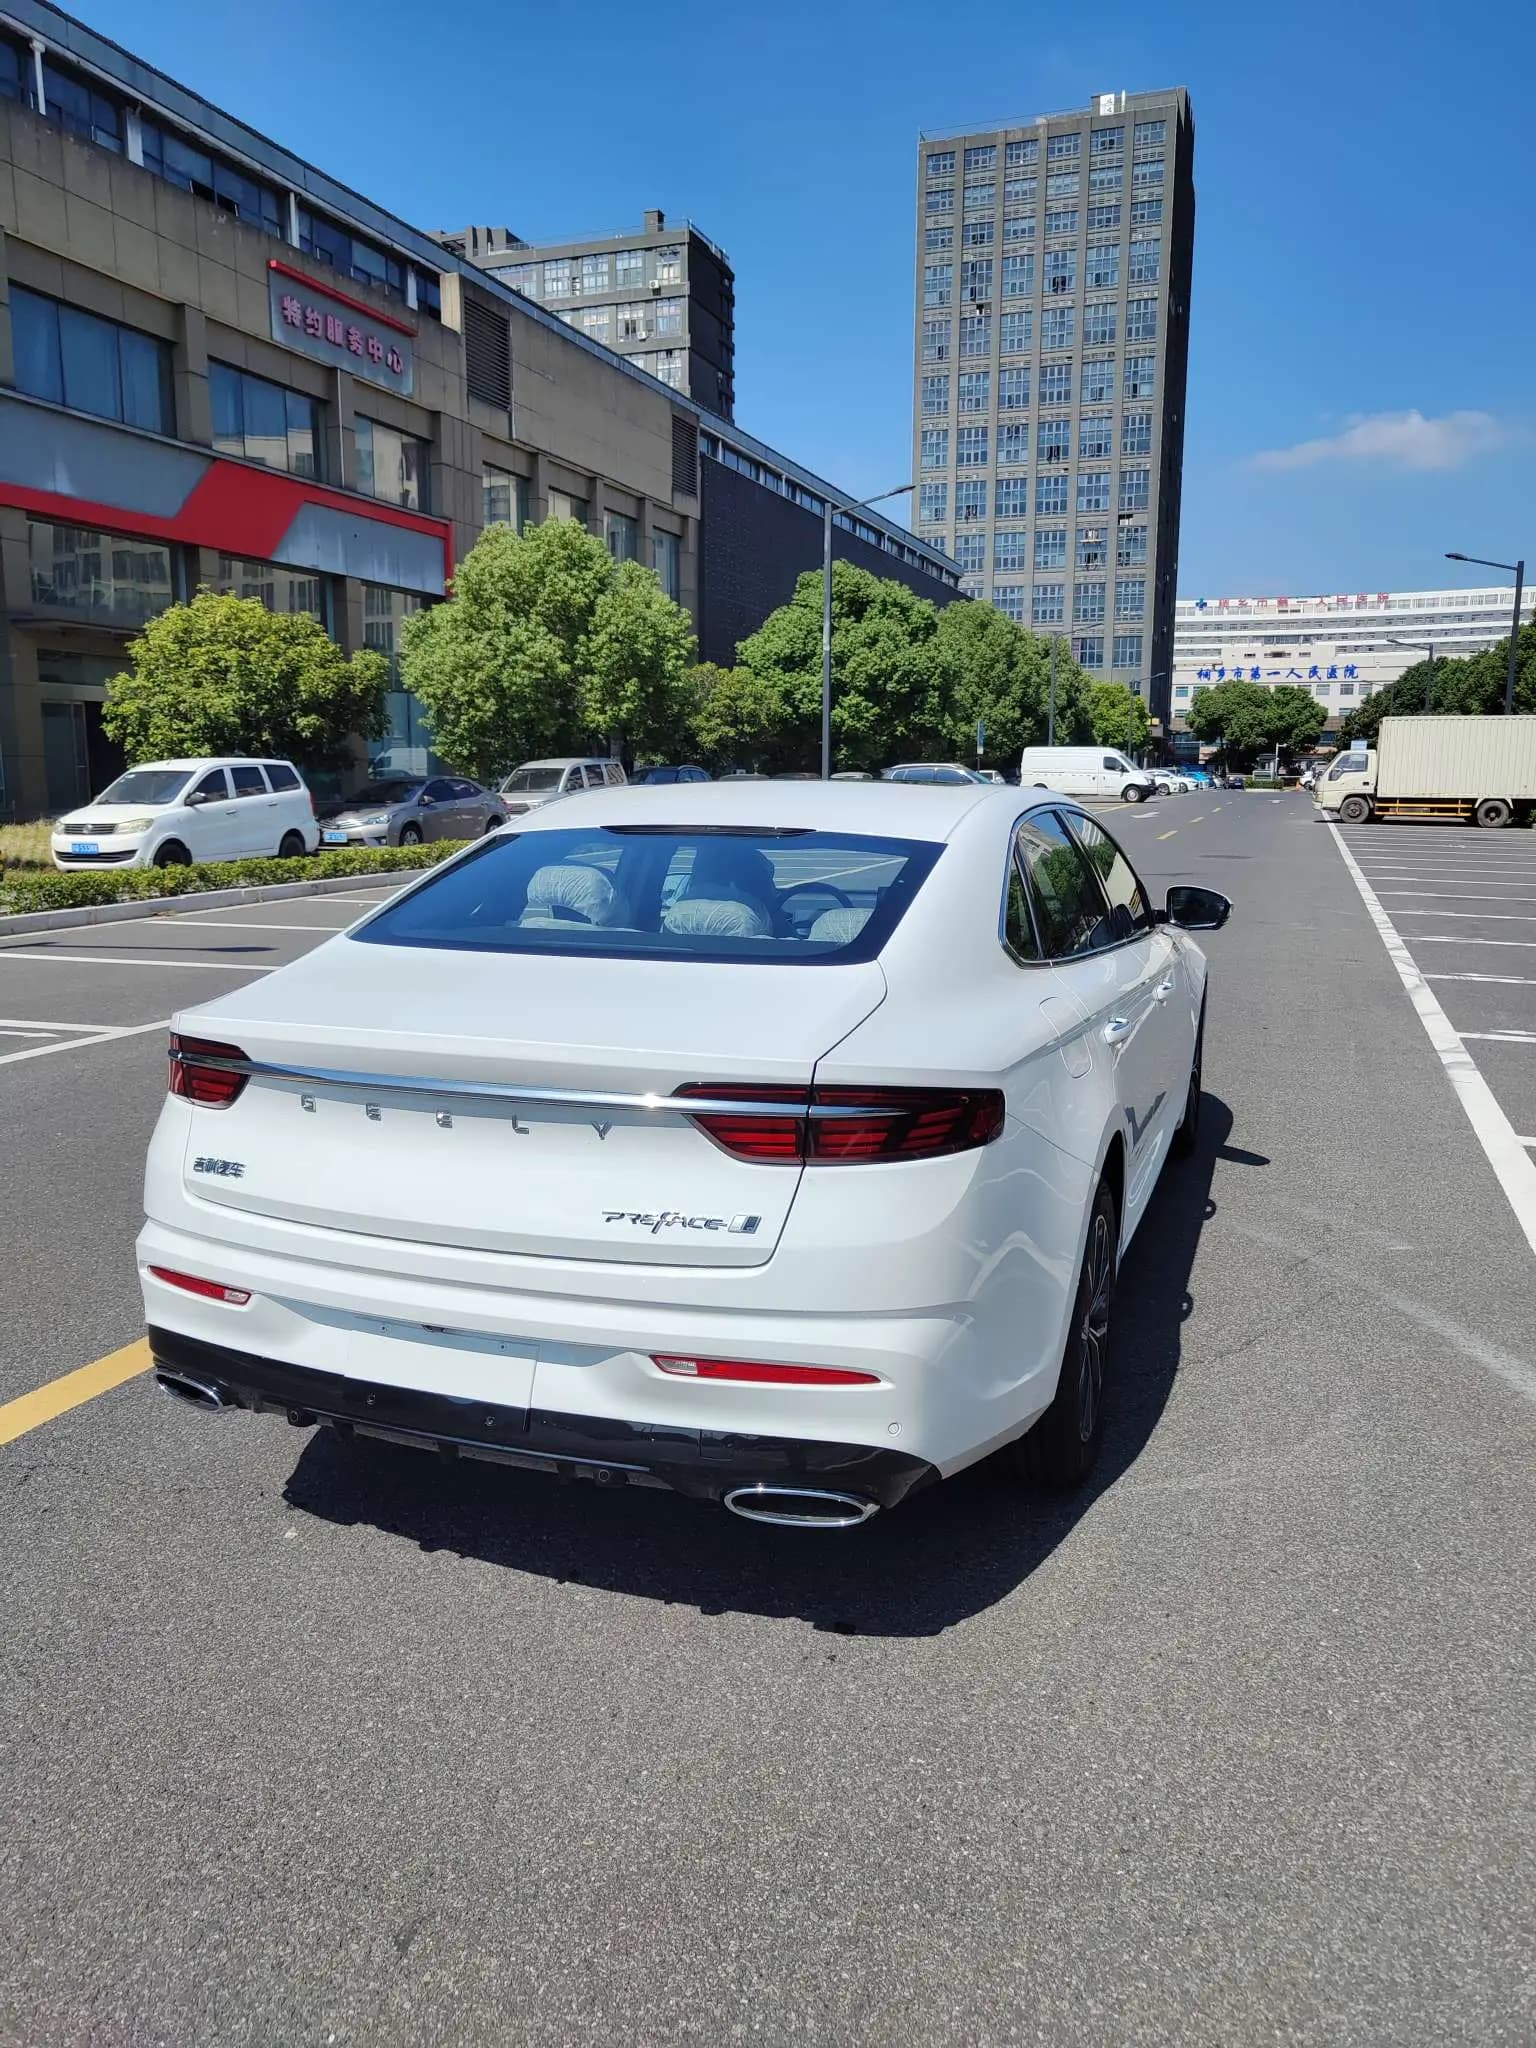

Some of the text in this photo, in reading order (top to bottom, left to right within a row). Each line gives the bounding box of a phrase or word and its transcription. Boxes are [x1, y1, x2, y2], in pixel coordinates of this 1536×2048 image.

[281, 295, 404, 375] 特约服务中心
[1218, 592, 1390, 609] 桐乡市第一人民医院
[1196, 664, 1360, 682] 桐乡市第一人民医院
[300, 1094, 613, 1141] GEELY
